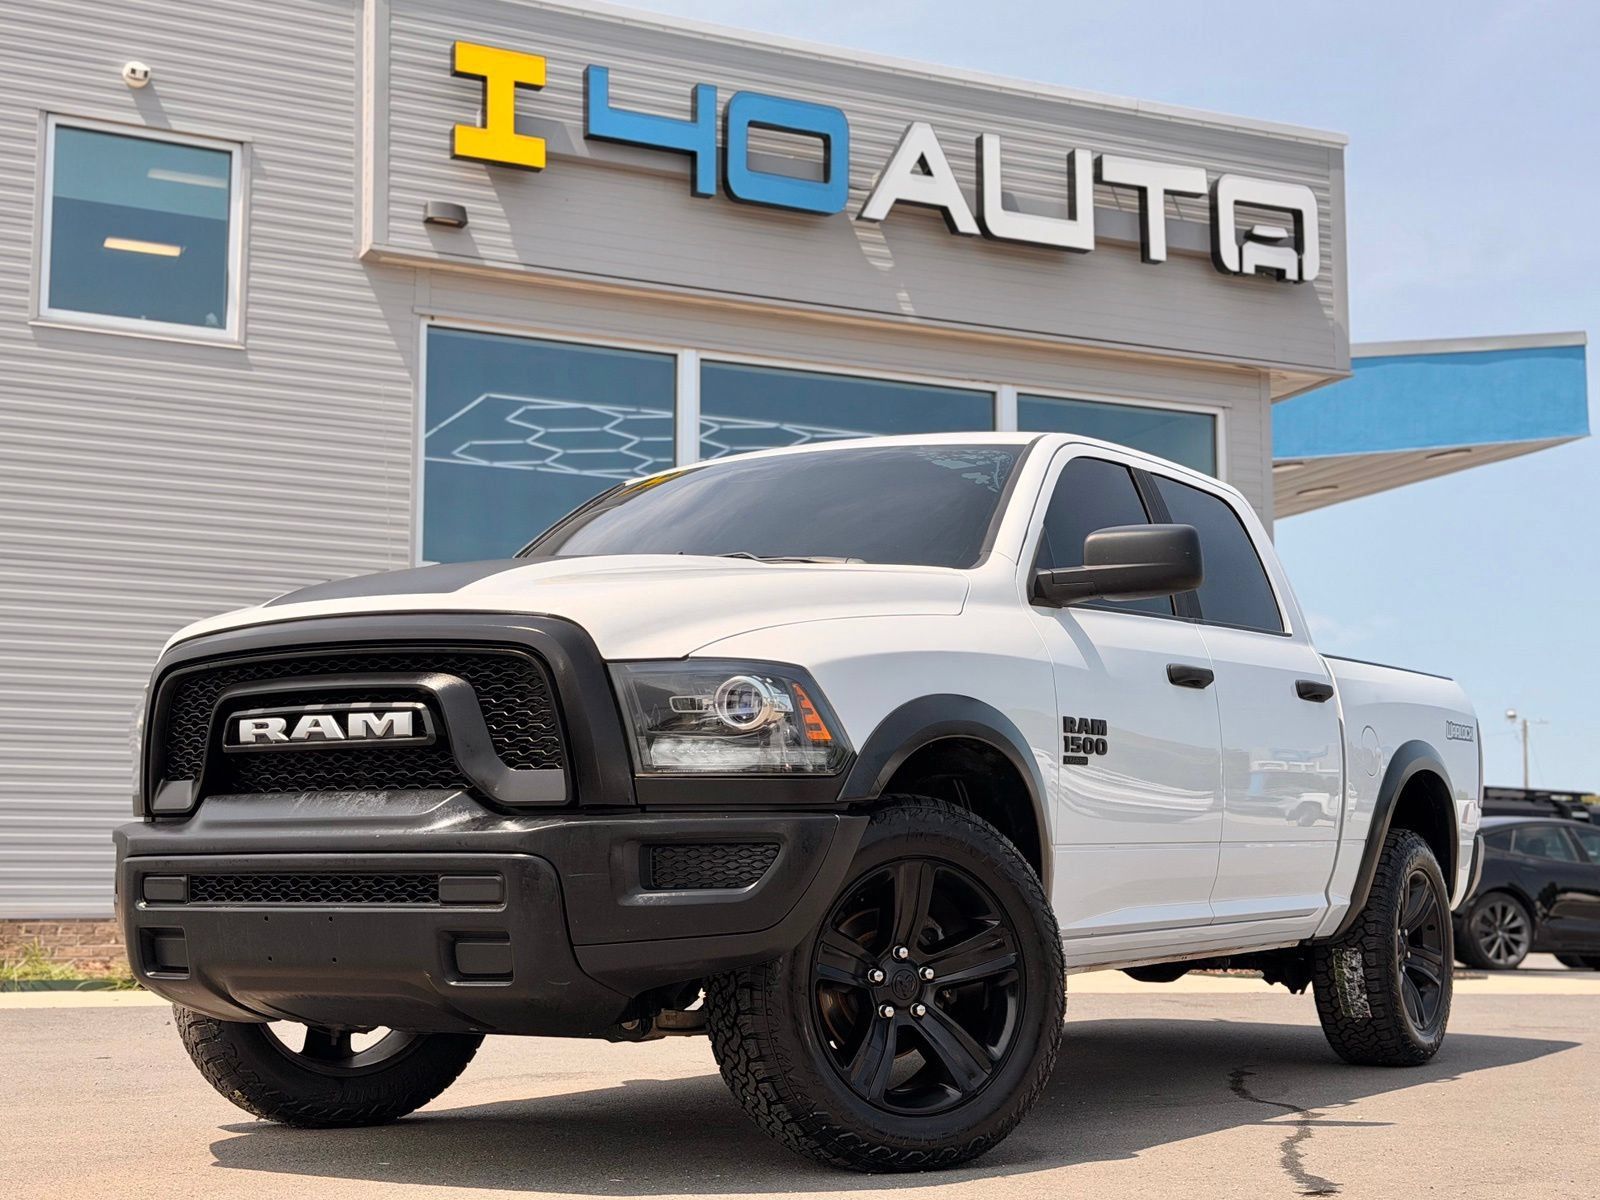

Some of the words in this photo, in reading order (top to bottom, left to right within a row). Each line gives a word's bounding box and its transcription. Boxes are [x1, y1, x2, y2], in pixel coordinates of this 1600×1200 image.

[856, 121, 1320, 283] AUTO
[239, 711, 413, 744] RAM
[1063, 716, 1107, 736] RAM
[1063, 735, 1108, 755] 1500
